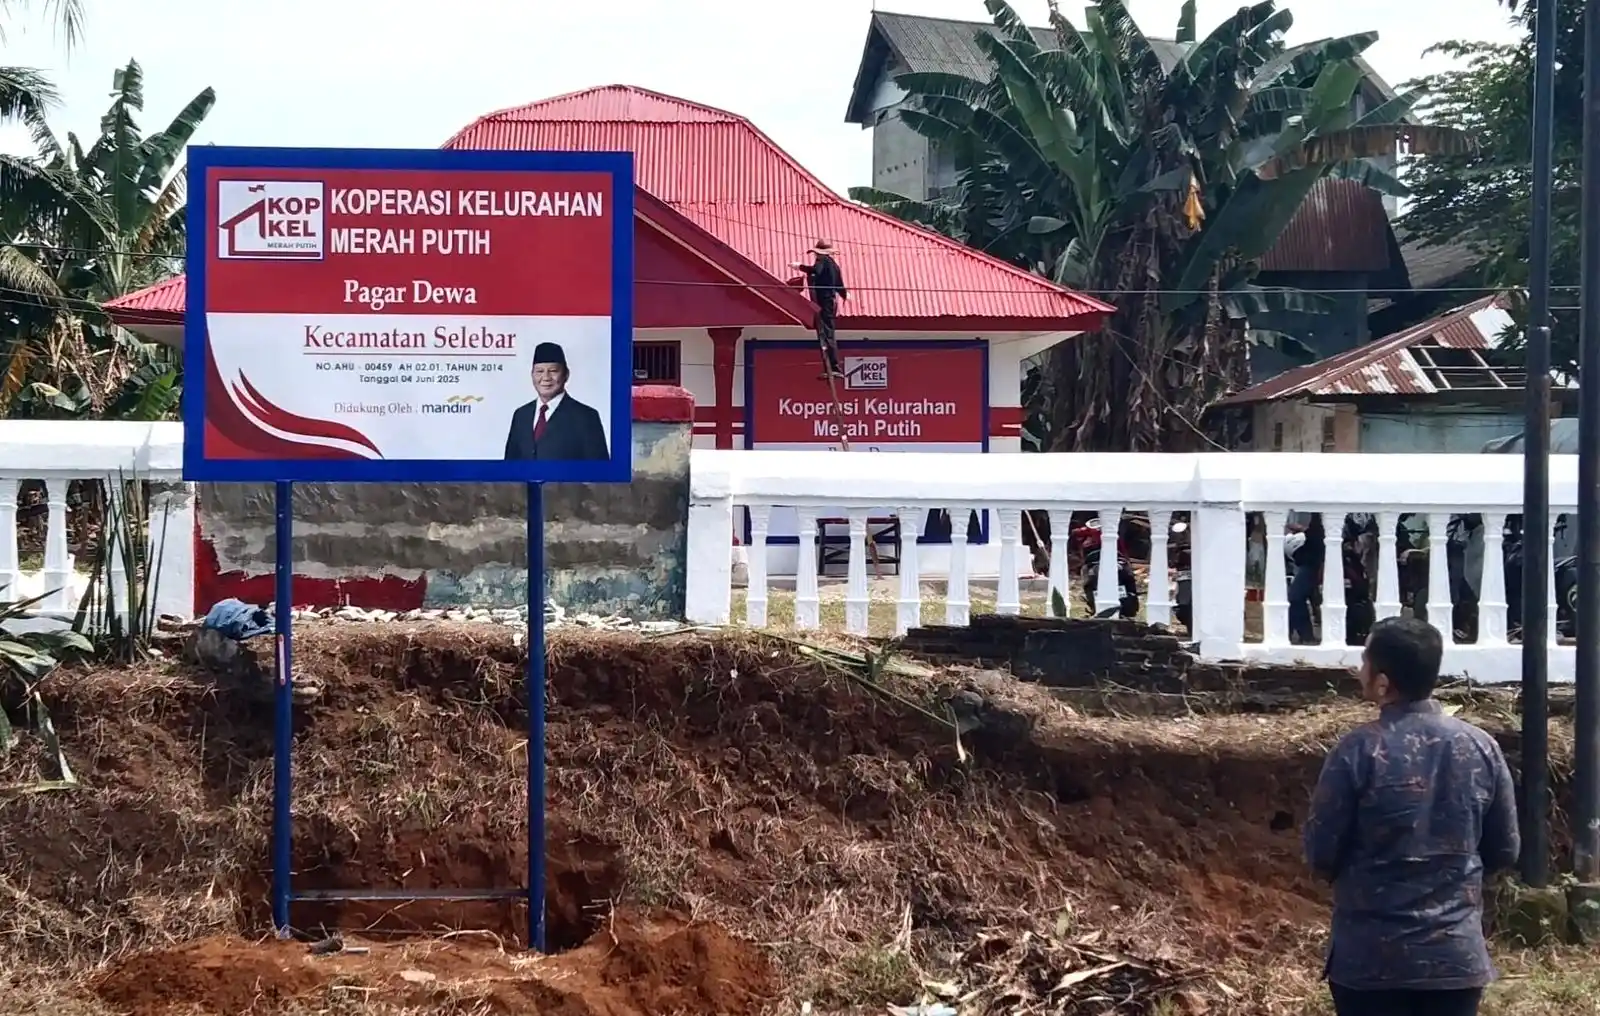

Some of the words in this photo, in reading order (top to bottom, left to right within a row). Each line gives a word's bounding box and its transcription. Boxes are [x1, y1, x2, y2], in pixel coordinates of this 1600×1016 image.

[268, 197, 320, 215] KOP
[331, 188, 451, 216] KOPERASI
[458, 190, 603, 217] KELURAHAN
[268, 219, 317, 237] KEL
[330, 229, 415, 255] MERAH
[422, 229, 491, 255] PUTIH
[343, 280, 407, 310] Pagar
[413, 280, 477, 305] Dewa
[303, 325, 426, 348] Kecamatan
[433, 325, 517, 349] Selebar
[364, 362, 393, 371] 00459
[446, 363, 478, 372] TAHUN
[480, 363, 503, 372] 2014
[864, 363, 886, 371] KOP
[360, 375, 399, 384] Tanggal
[401, 375, 412, 383] 04
[415, 375, 435, 383] Juni
[437, 375, 460, 383] 2025
[864, 372, 886, 380] KEL
[334, 402, 386, 415] Didukung
[387, 402, 413, 414] Oleh
[421, 402, 472, 414] mandiri
[864, 398, 956, 415] Kelurahan
[874, 419, 921, 436] Putih
